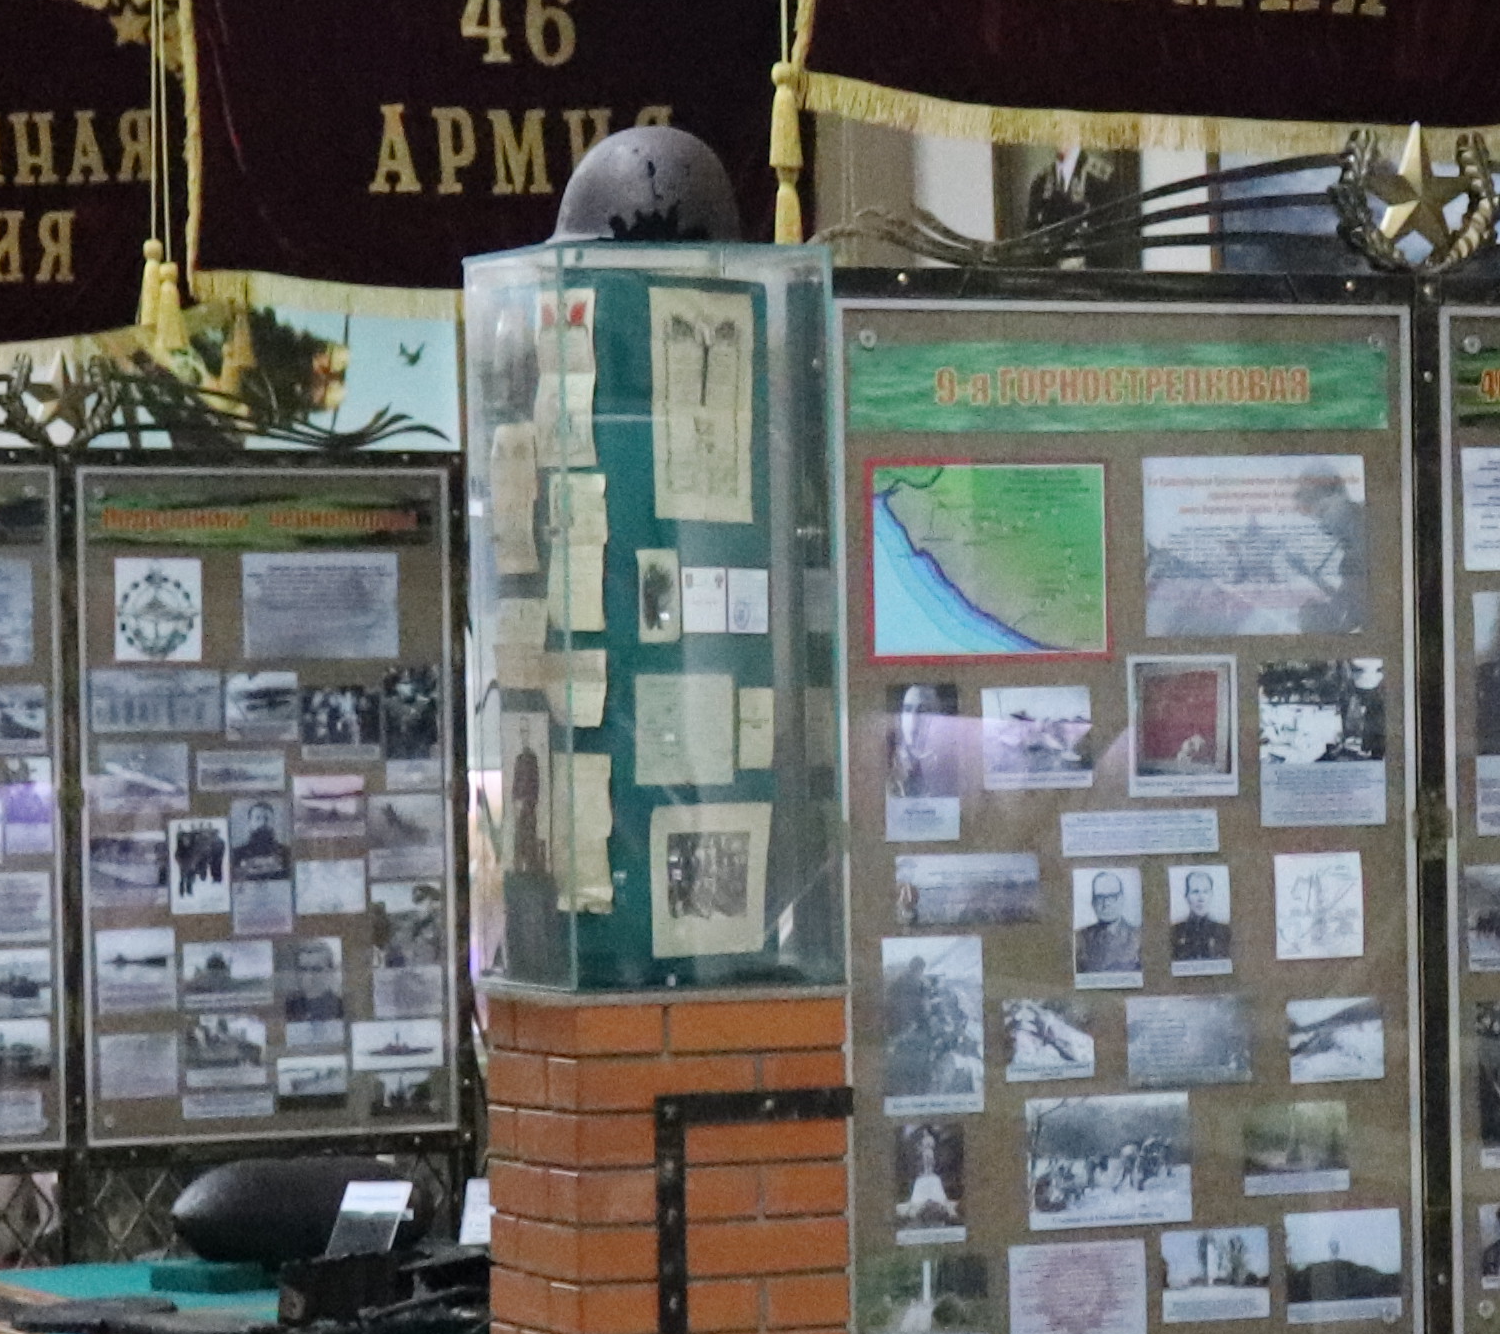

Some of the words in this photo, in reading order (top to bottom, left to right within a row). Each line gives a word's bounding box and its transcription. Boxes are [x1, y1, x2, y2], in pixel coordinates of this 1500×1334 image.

[368, 103, 674, 195] АРМИ
[935, 367, 990, 405] 9-я
[999, 366, 1311, 405] ГОРНОСТРЕЛКОВАЯ
